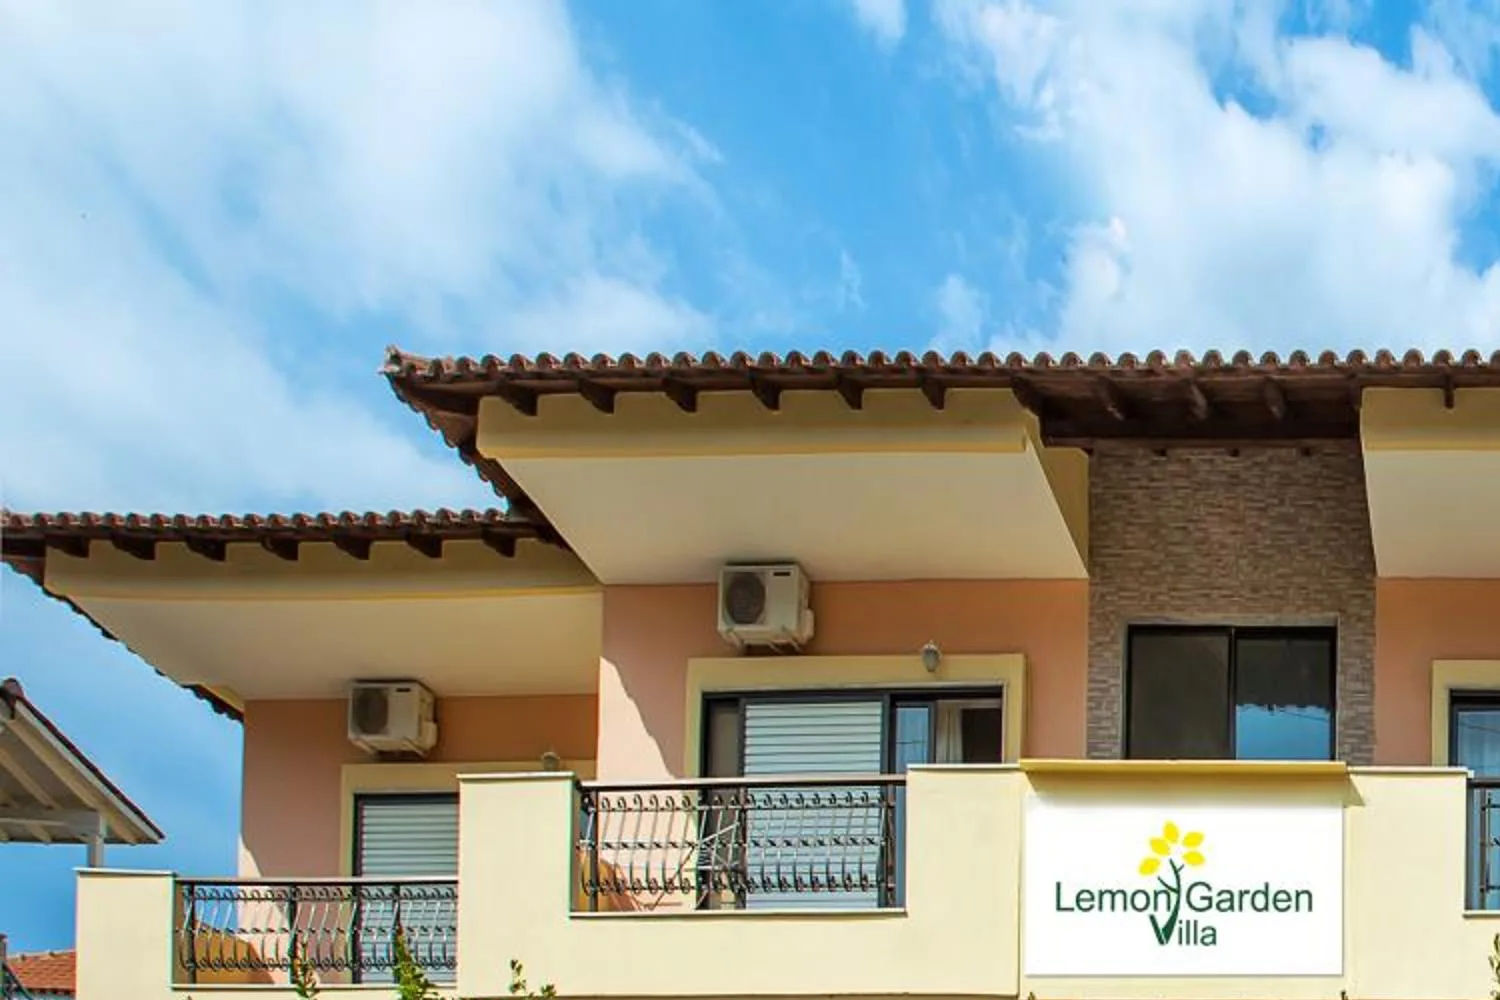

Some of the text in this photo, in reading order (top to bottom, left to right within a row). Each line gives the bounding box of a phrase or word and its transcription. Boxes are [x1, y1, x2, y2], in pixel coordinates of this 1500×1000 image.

[1055, 881, 1313, 913] Lemon Garden
[1149, 914, 1217, 946] Villa
